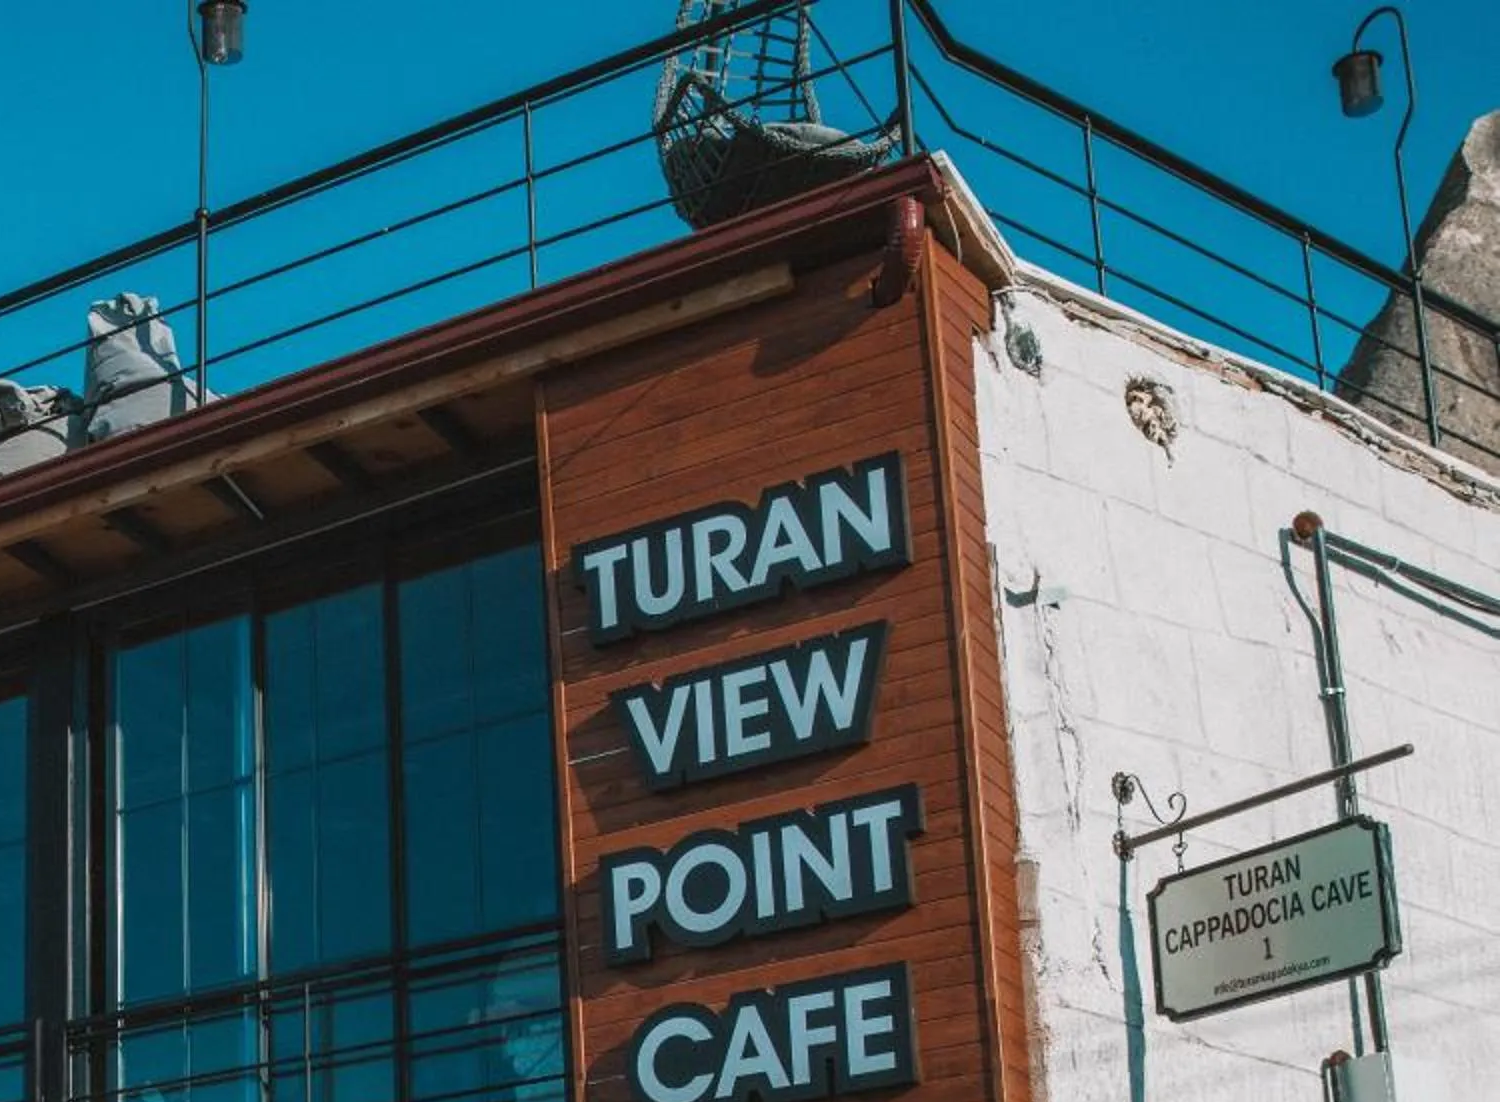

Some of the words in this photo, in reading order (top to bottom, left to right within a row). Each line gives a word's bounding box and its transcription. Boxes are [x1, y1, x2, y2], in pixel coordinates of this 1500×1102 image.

[582, 466, 892, 630] TURAN
[625, 636, 869, 776] VIEW
[610, 799, 902, 950] POINT
[1164, 892, 1306, 955] CAPPADOCIA
[1310, 870, 1373, 912] CAVE
[1223, 853, 1302, 901] TURAN
